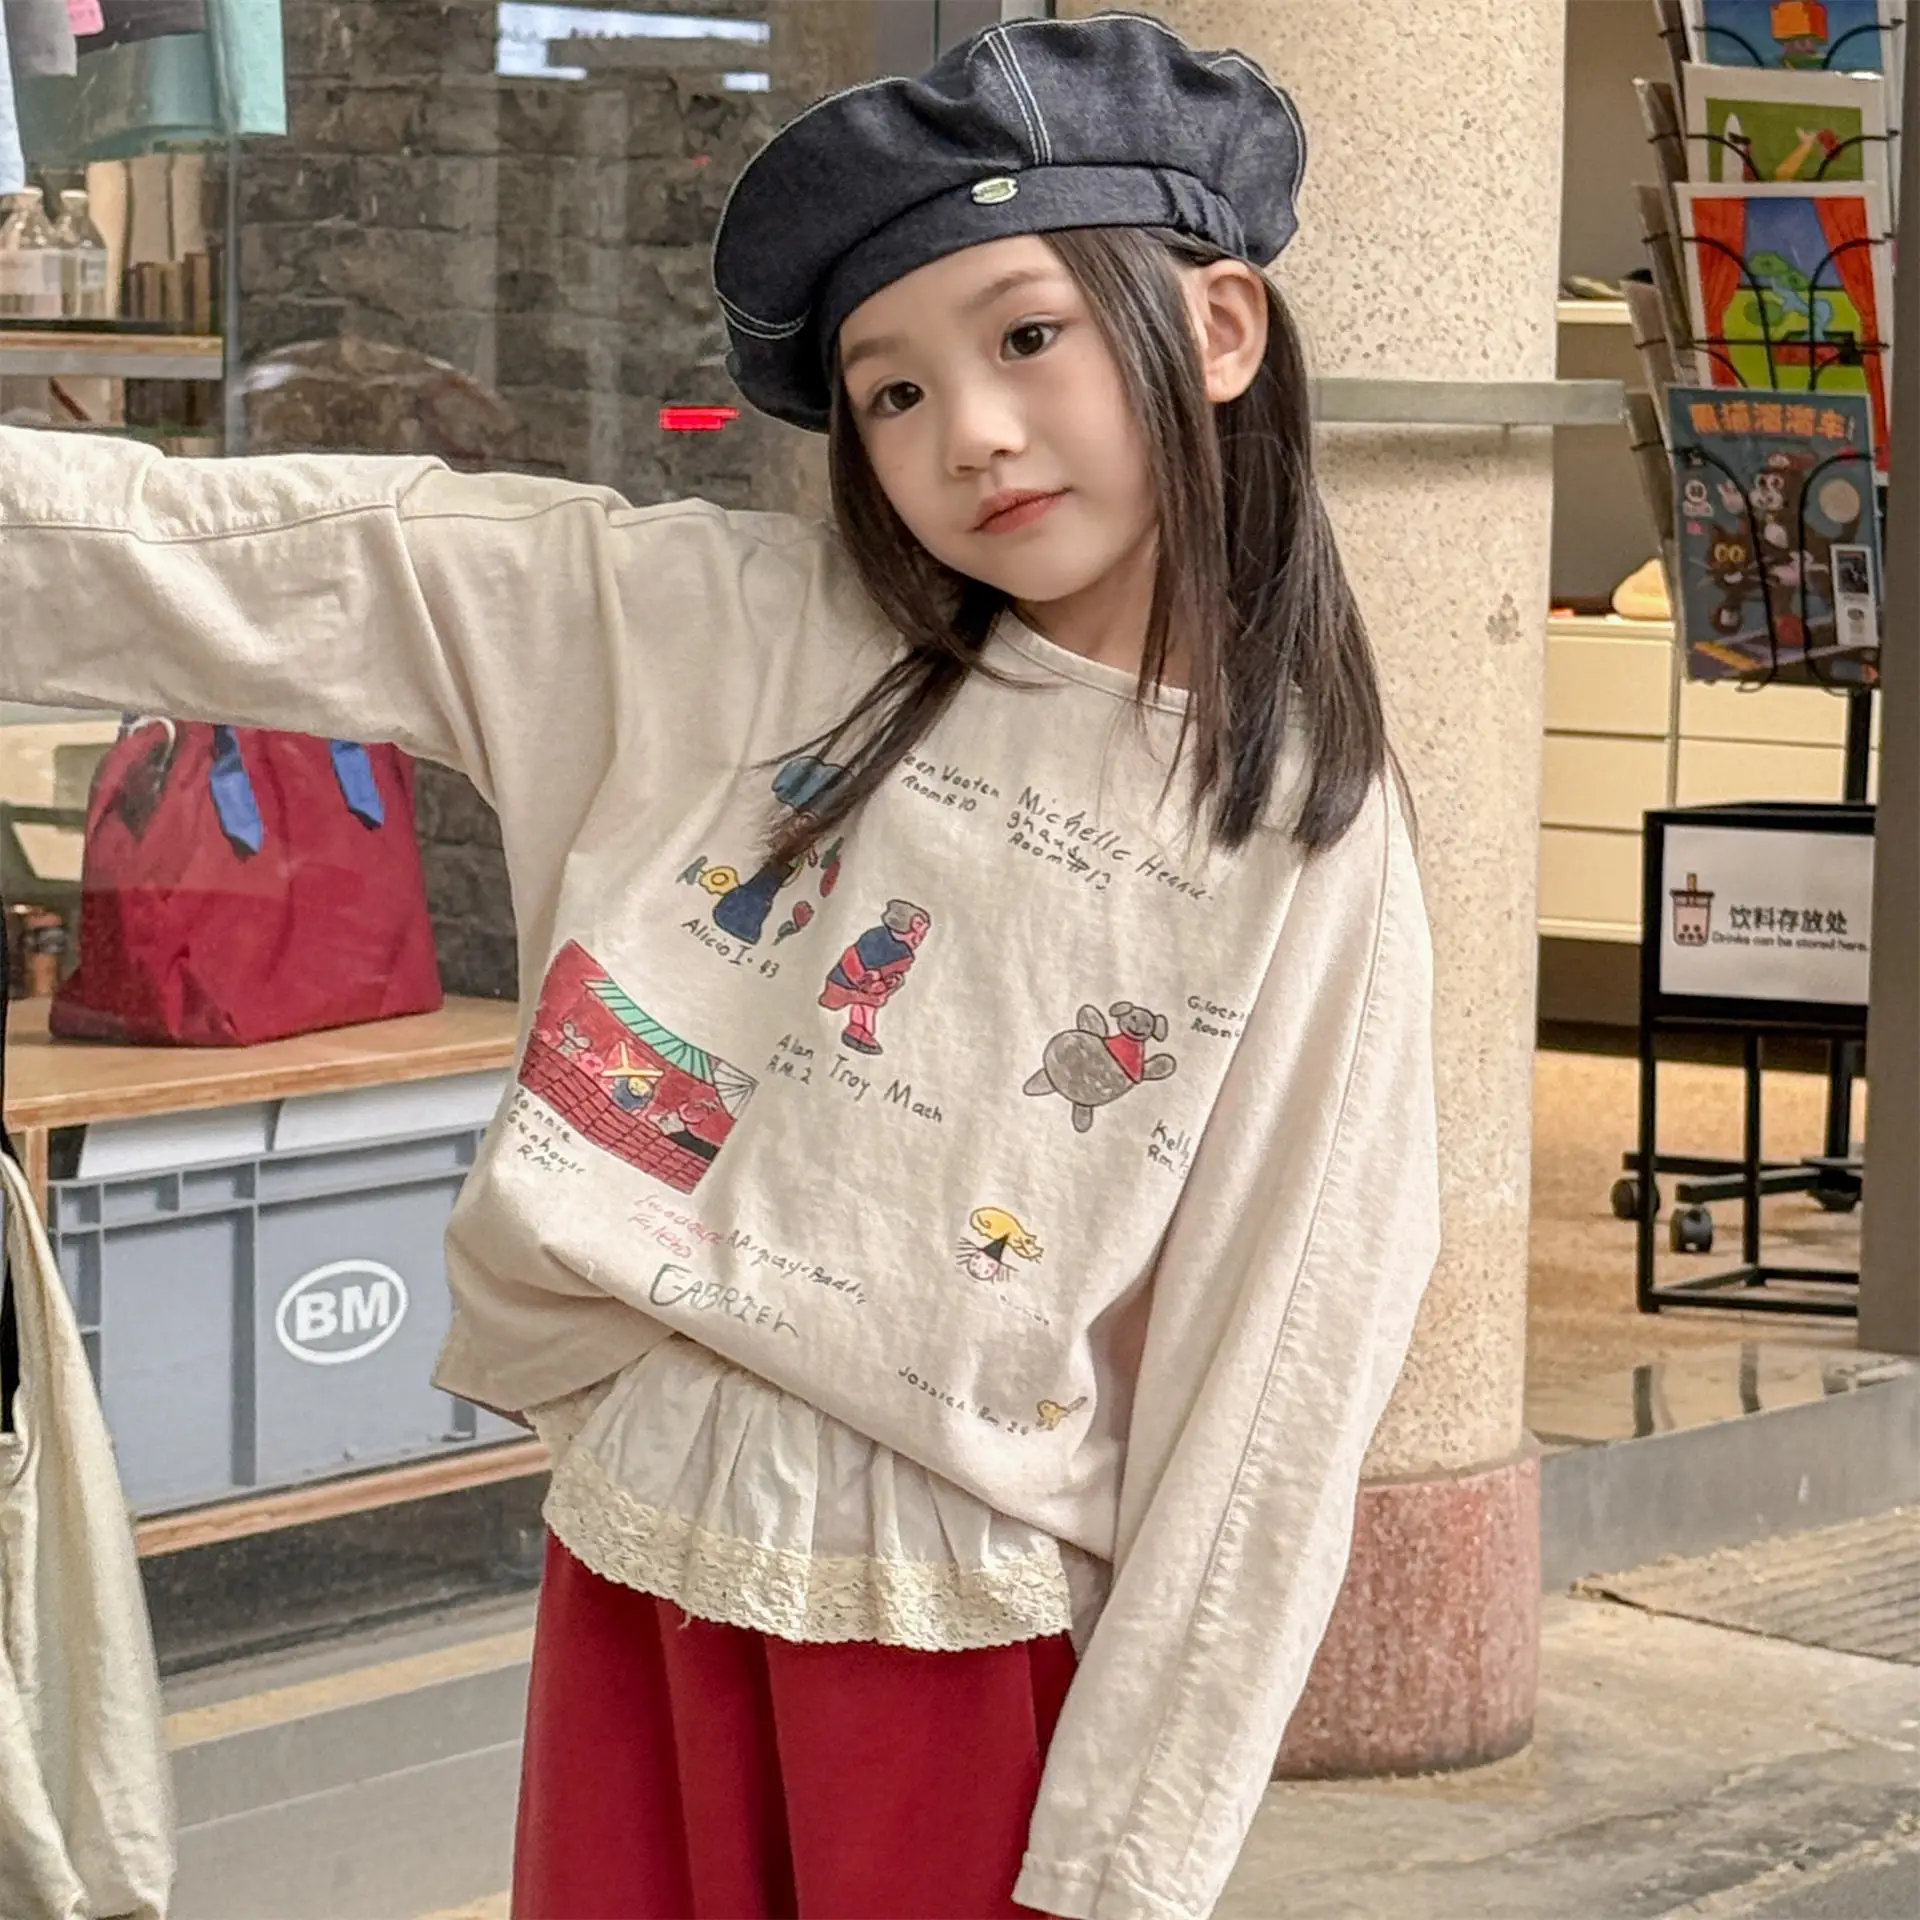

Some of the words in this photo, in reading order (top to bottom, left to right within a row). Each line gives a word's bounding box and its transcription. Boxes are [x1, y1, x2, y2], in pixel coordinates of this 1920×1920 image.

[1729, 903, 1847, 936] 饮料存放处
[1711, 930, 1750, 946] Drinks
[1752, 935, 1774, 948] can
[1777, 934, 1793, 949] be
[1795, 936, 1836, 951] stored
[295, 1281, 390, 1342] BM
